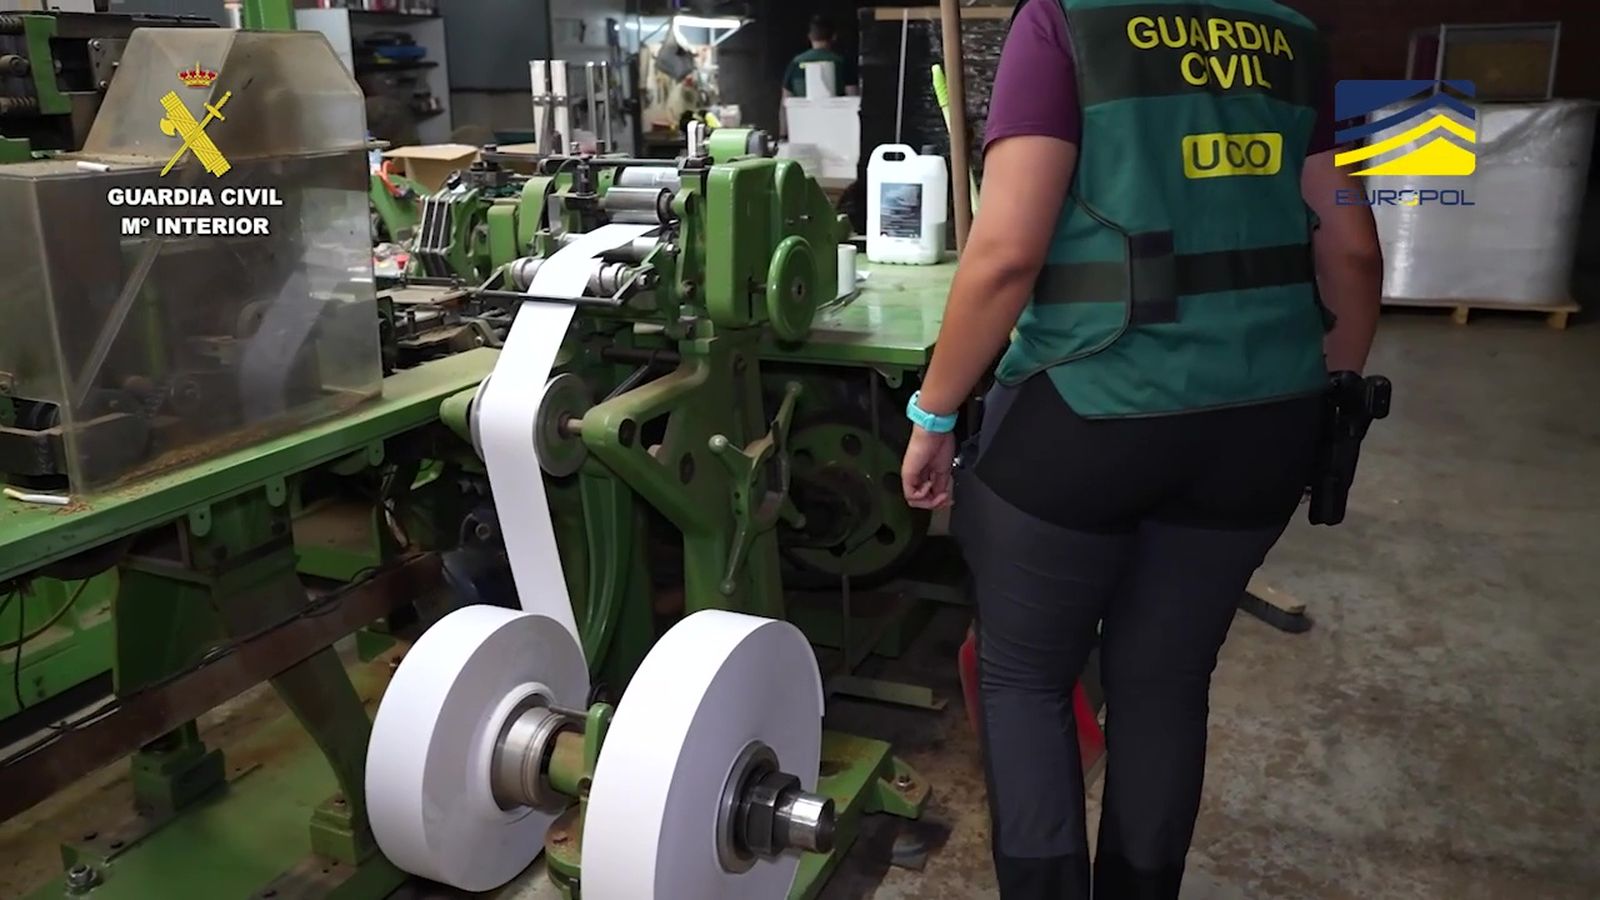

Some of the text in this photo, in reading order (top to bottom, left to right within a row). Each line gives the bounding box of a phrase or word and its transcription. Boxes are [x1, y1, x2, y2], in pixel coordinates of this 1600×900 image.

[1127, 16, 1294, 60] GUARDIA
[1180, 52, 1271, 89] CVIL
[1191, 140, 1271, 170] UCO
